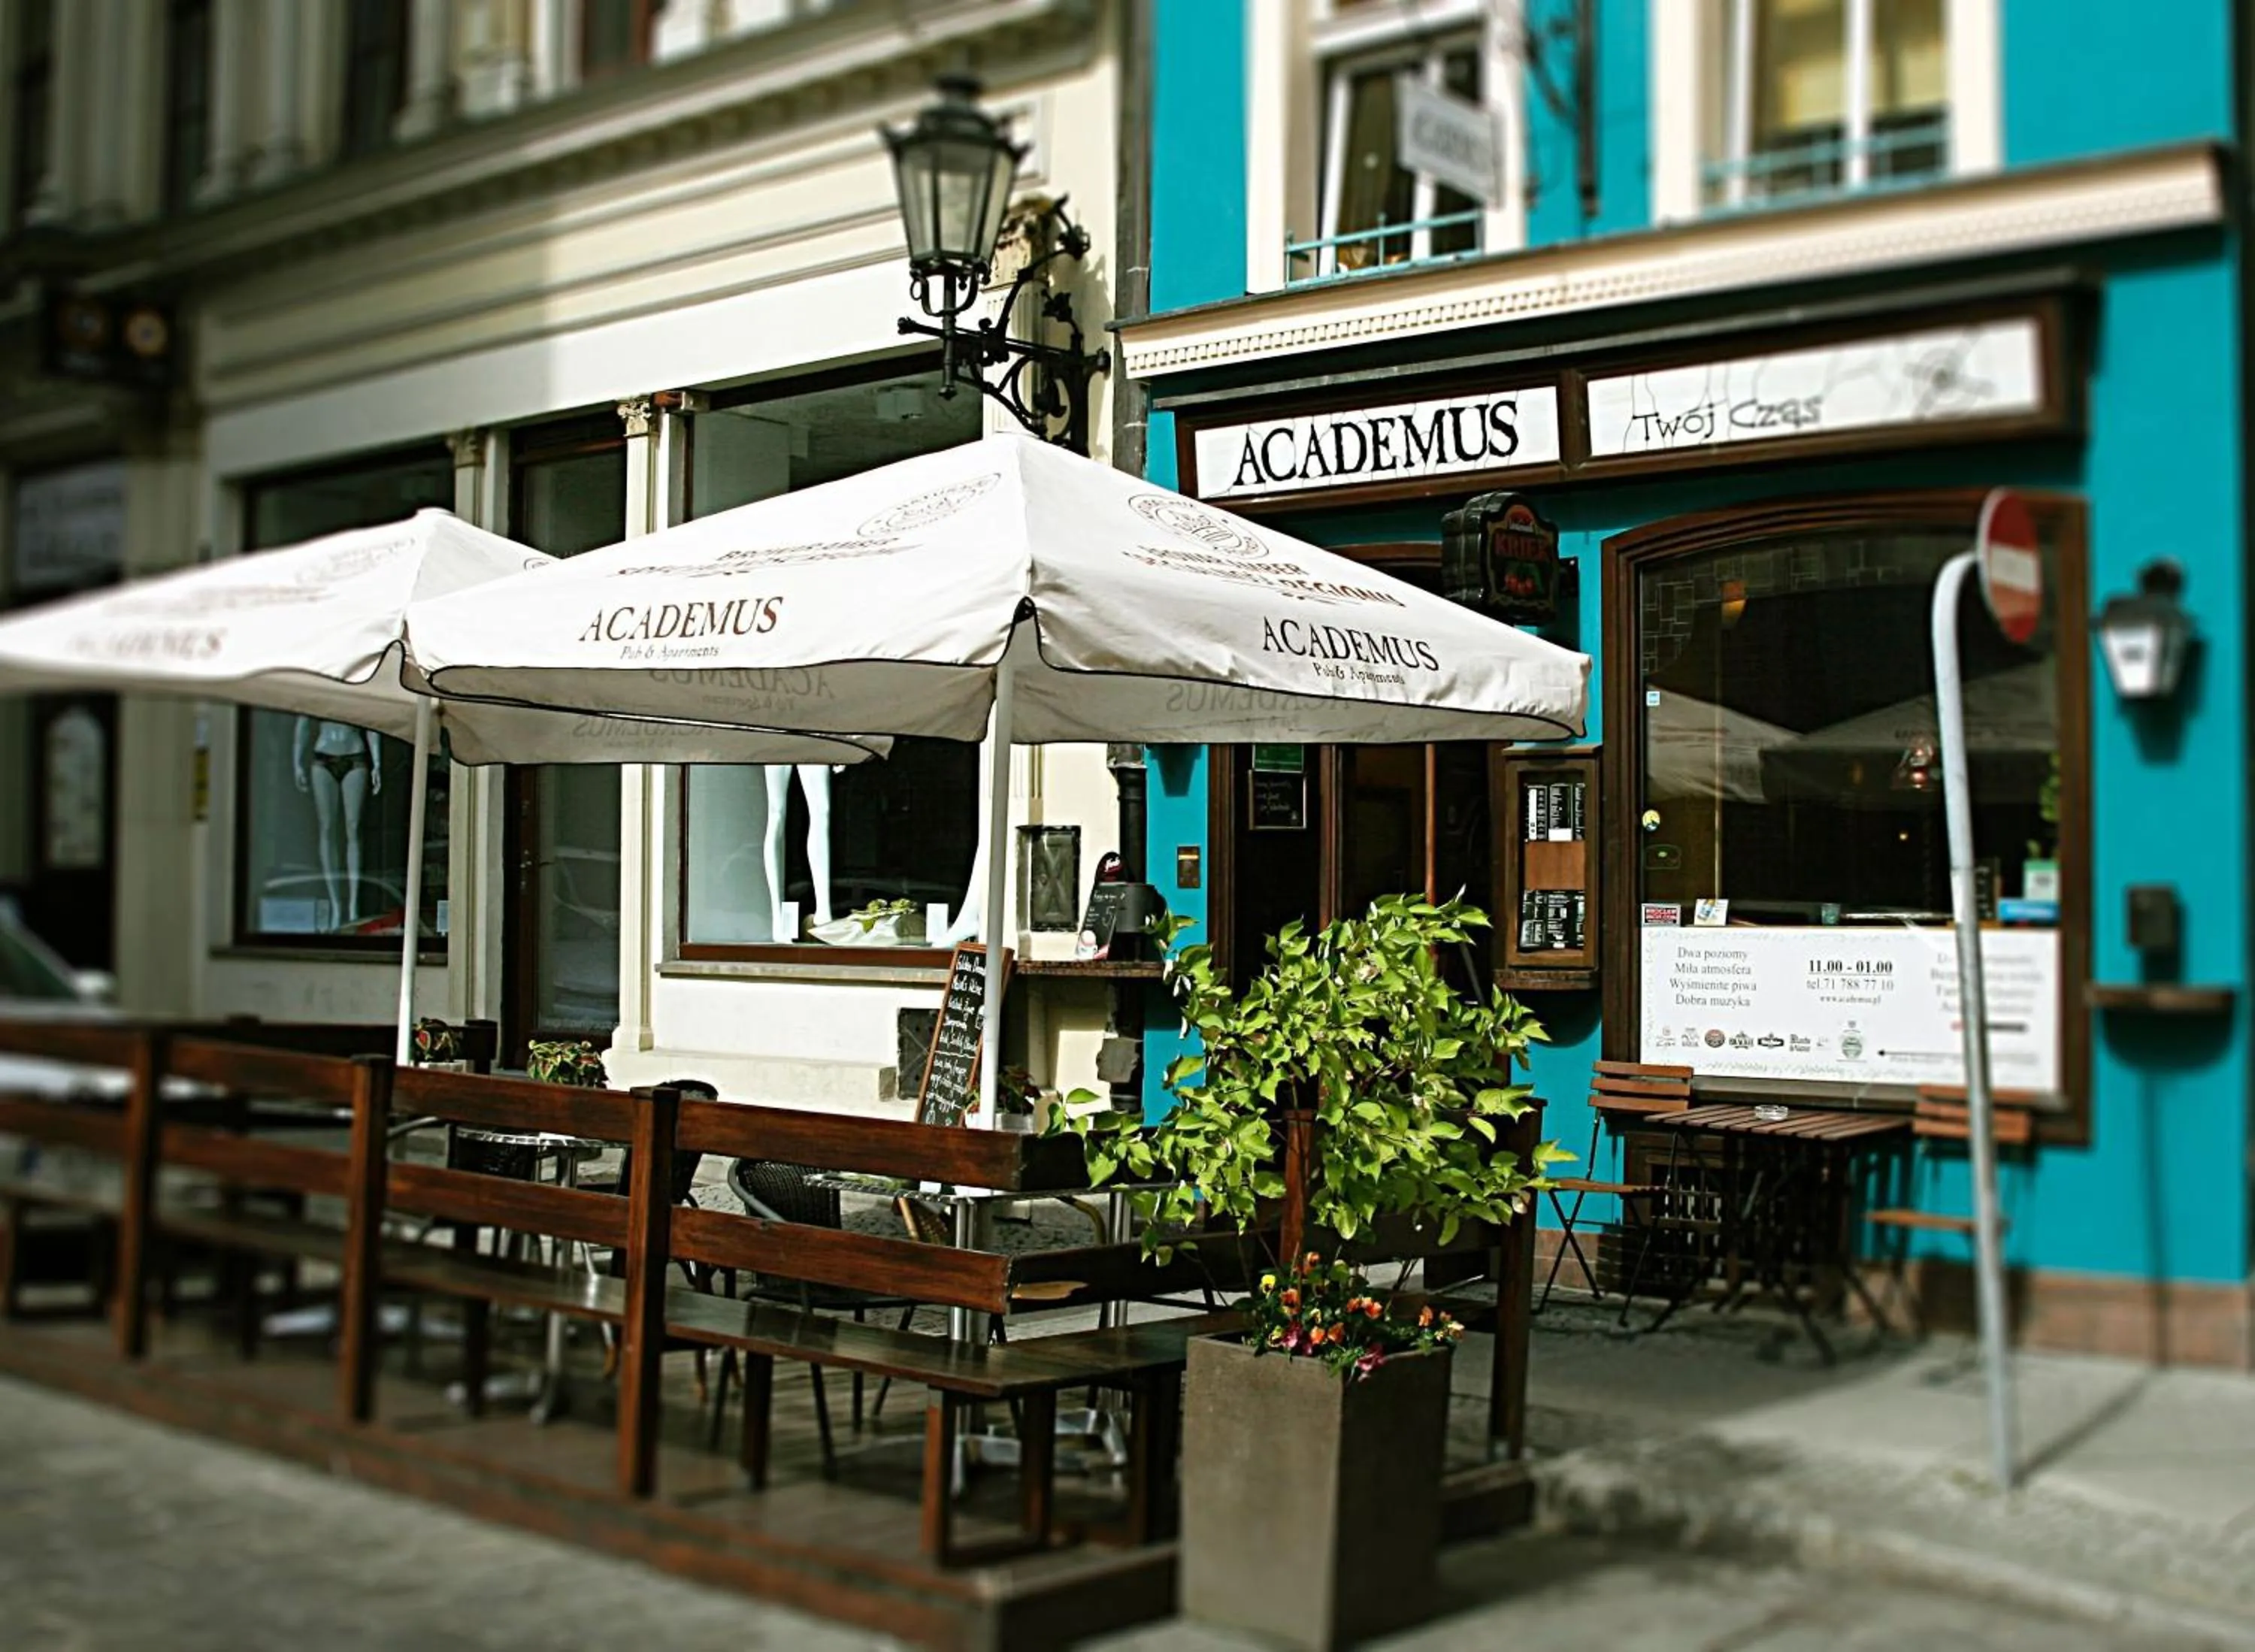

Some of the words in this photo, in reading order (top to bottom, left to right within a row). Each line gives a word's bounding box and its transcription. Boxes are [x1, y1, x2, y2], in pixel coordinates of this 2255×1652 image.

[1633, 403, 1715, 440] Twój
[1233, 401, 1519, 486] ACADEMUS
[579, 596, 783, 642] ACADEMUS
[1263, 616, 1439, 671] ACADEMUS
[620, 646, 641, 659] Pub
[1677, 946, 1701, 958] Dwa
[1704, 949, 1748, 961] poziomy
[1701, 964, 1751, 975] atmosfera
[1809, 960, 1842, 973] 11.00
[1856, 961, 1893, 973] 01.00
[1669, 978, 1729, 991] Wyśmienite
[1731, 981, 1757, 993] piwa
[1841, 978, 1860, 990] 788
[1864, 979, 1877, 991] 77
[1881, 979, 1894, 991] 10
[1675, 994, 1706, 1005] Dobra
[1710, 995, 1751, 1009] muzyka
